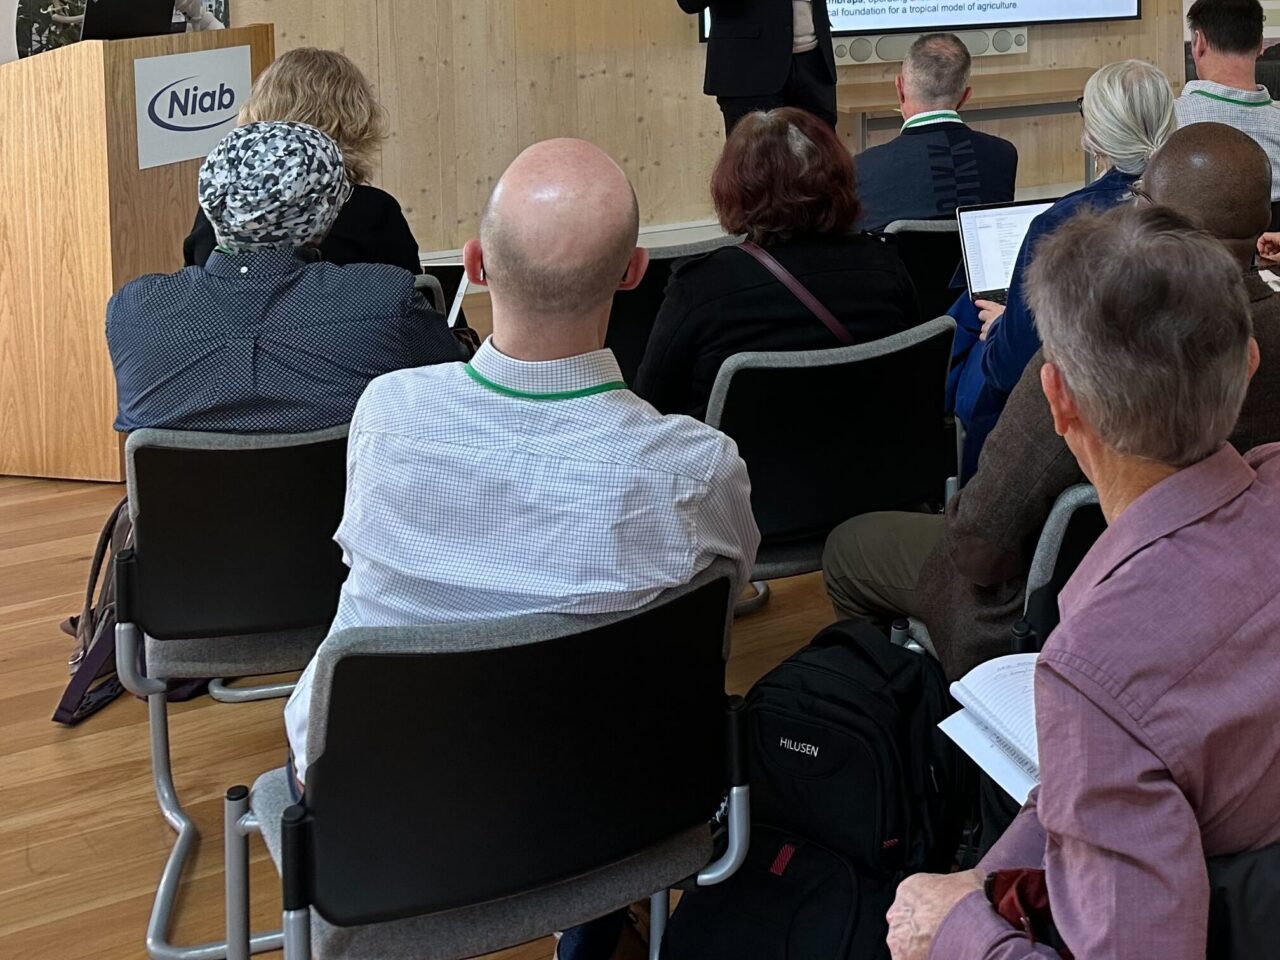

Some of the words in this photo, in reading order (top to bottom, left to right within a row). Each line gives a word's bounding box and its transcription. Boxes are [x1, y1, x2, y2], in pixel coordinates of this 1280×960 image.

[842, 6, 886, 16] foundation
[888, 6, 900, 14] for
[910, 4, 938, 14] tropical
[941, 3, 966, 12] model
[968, 2, 976, 10] of
[168, 82, 235, 118] Niab
[780, 736, 818, 758] HILUSEN
